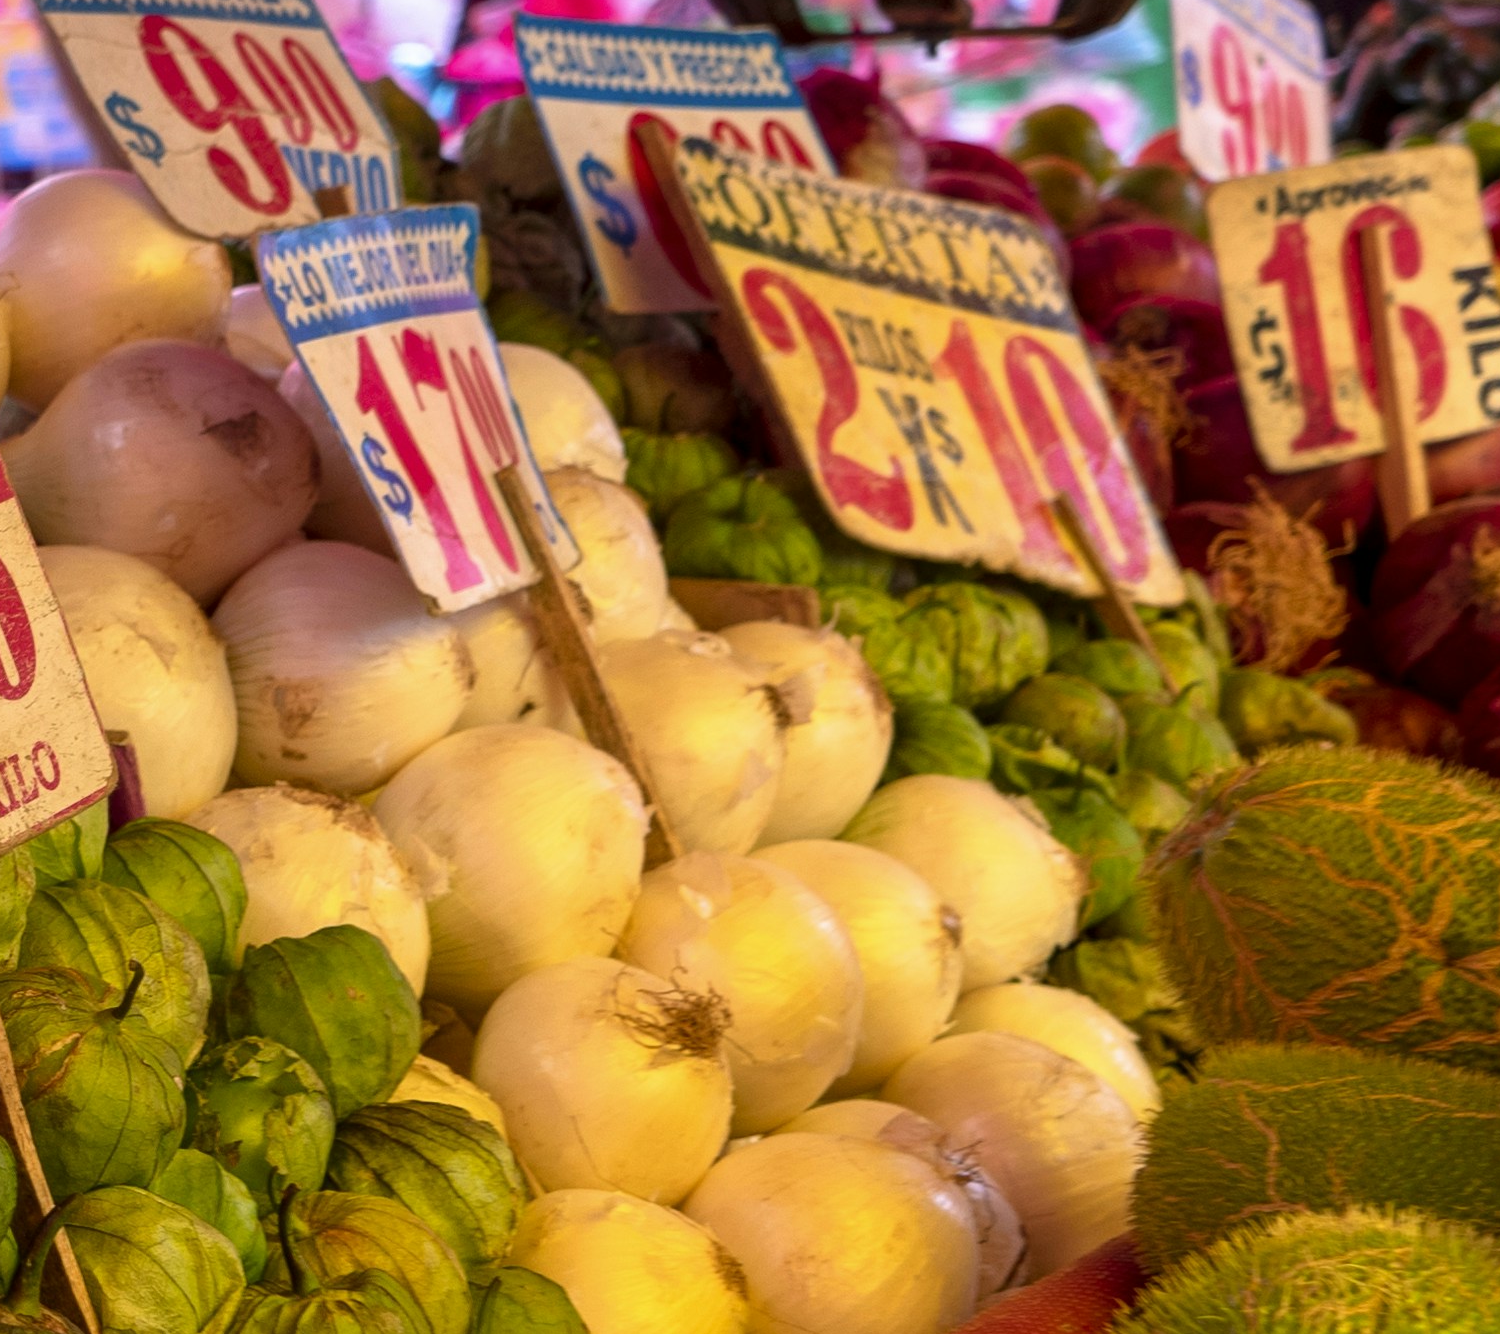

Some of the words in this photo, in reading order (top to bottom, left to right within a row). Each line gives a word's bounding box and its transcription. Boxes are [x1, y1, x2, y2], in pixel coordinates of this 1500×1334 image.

[287, 261, 328, 308] LO
[321, 245, 401, 301] MEJOR
[718, 171, 1034, 307] OFERTA
[1258, 204, 1448, 455] 16
[355, 326, 520, 594] 17
[360, 431, 414, 526] $
[741, 268, 915, 532] 2
[932, 319, 1152, 585] 10
